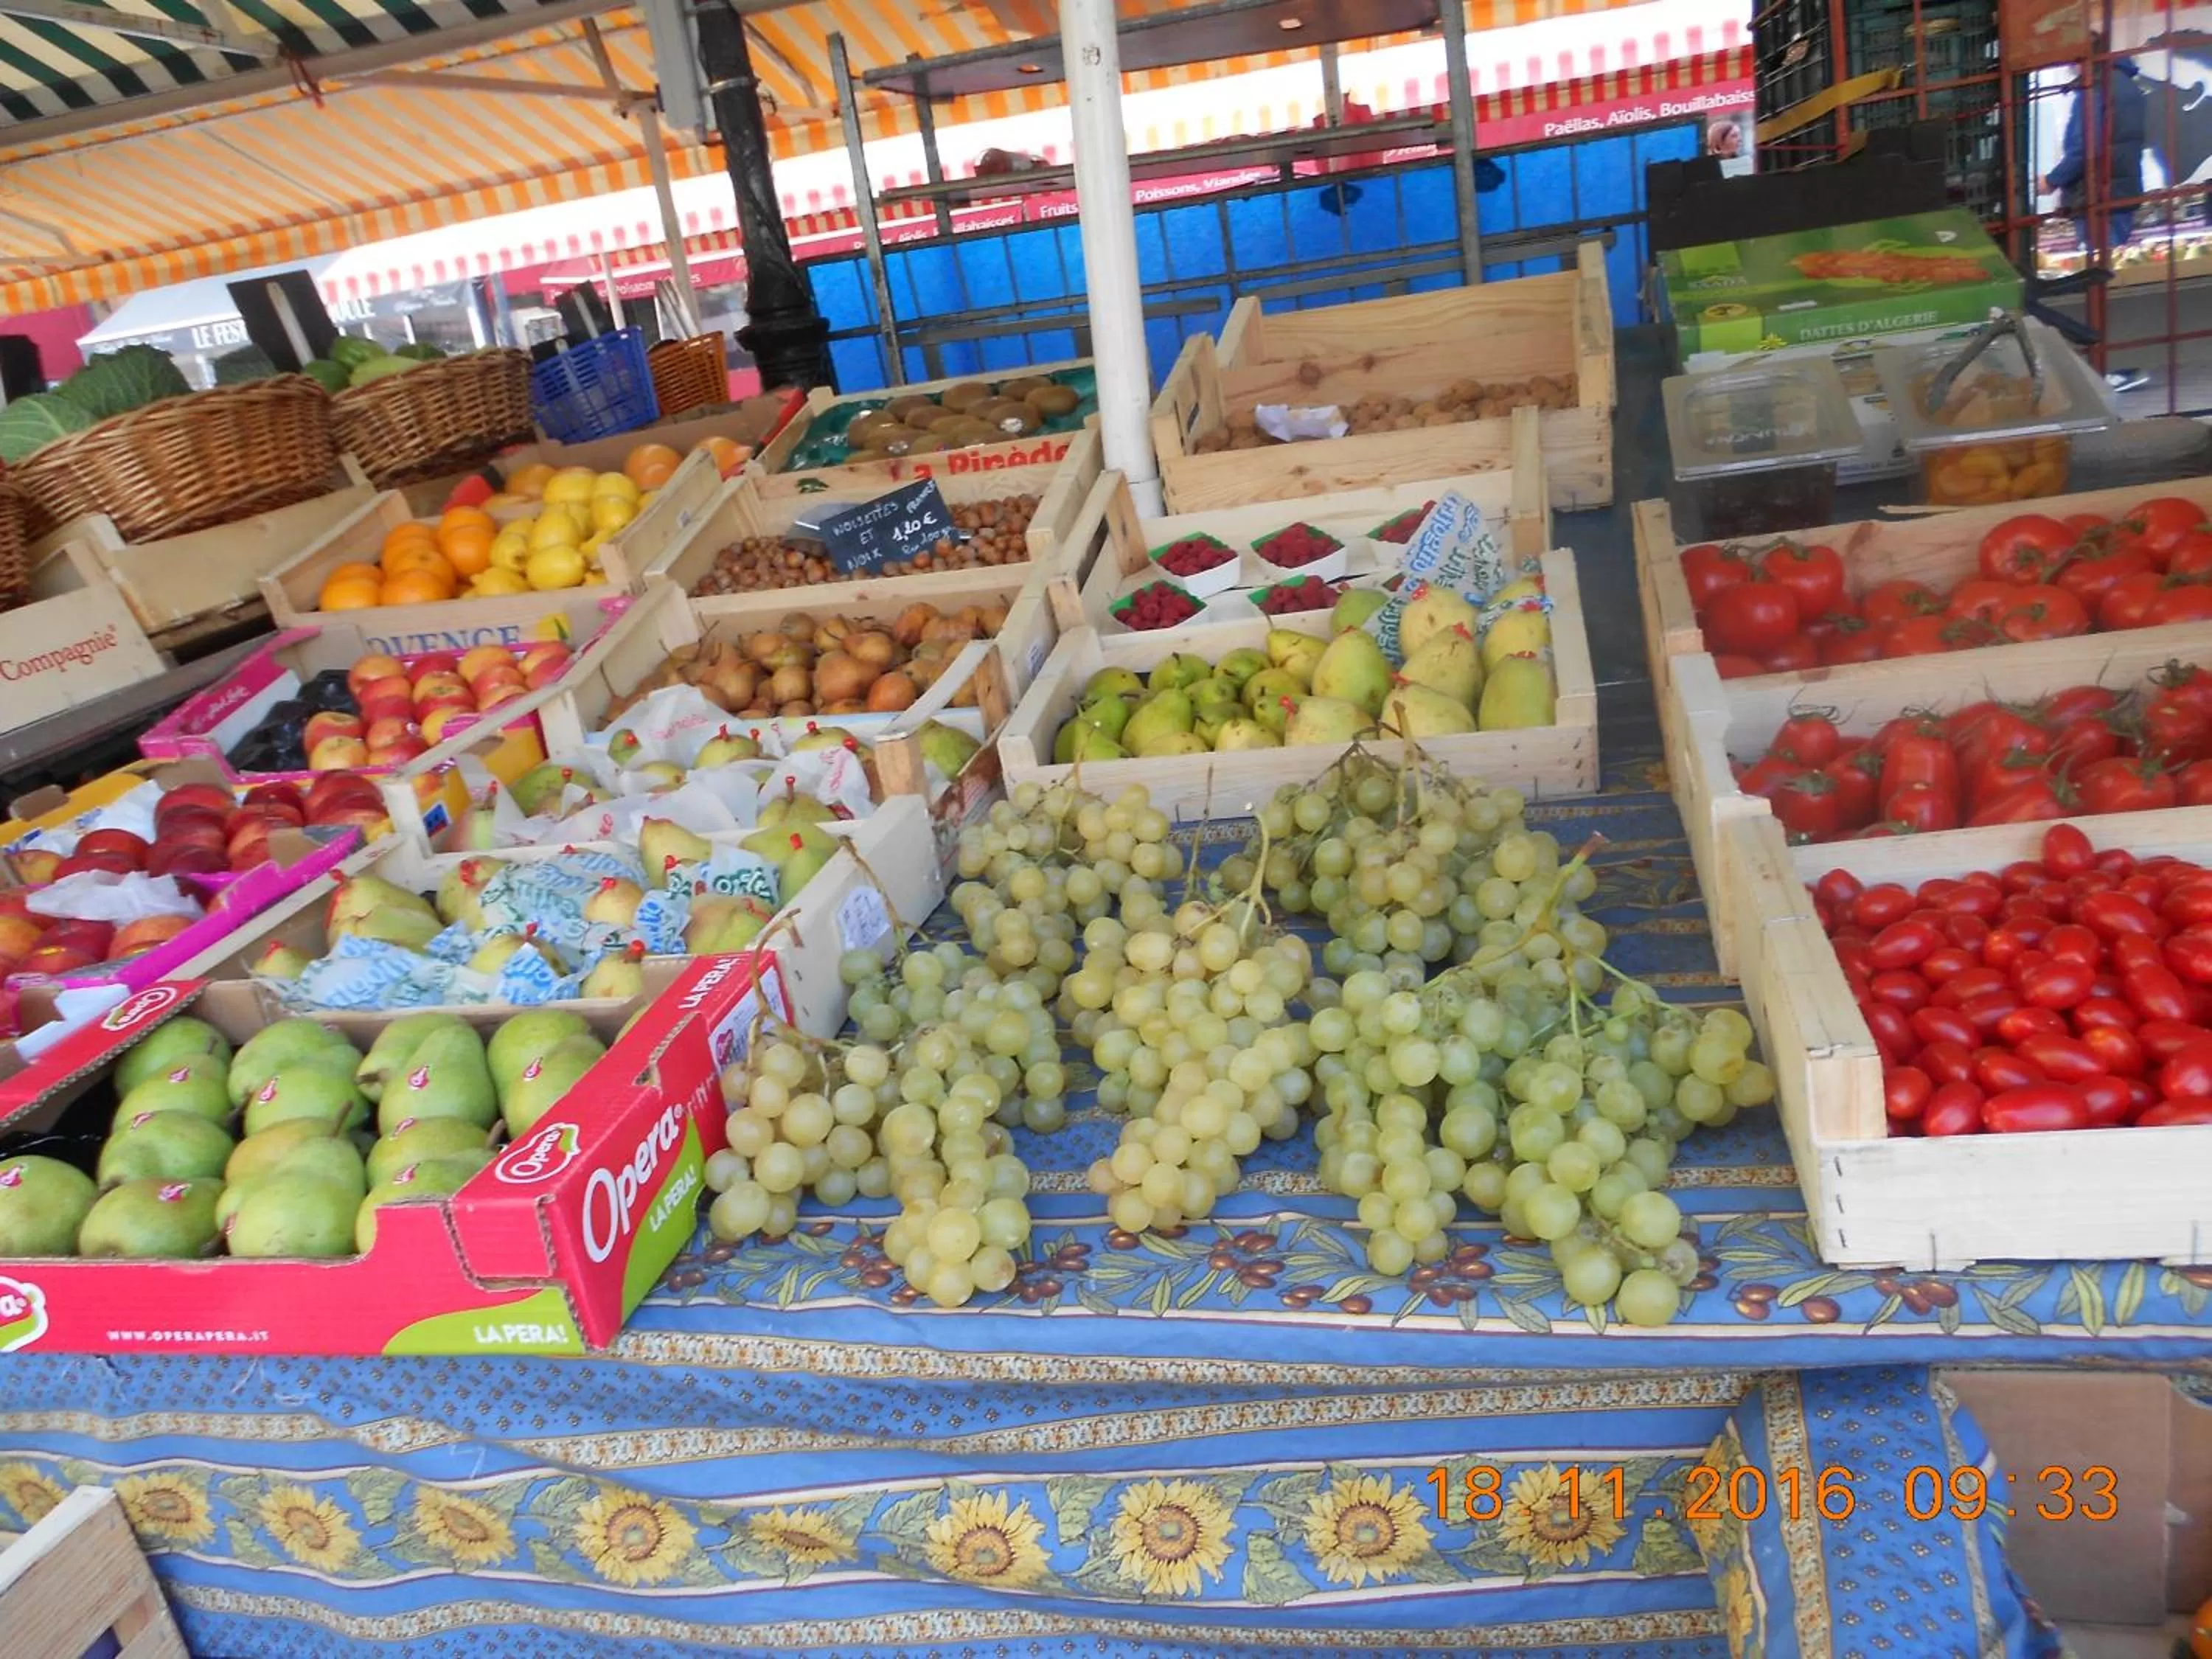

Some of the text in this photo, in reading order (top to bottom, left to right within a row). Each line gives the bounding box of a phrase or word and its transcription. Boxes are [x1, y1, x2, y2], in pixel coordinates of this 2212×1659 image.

[1040, 202, 1079, 219] Fruits
[191, 325, 213, 349] LE
[859, 527, 874, 546] ET
[846, 547, 883, 570] NOIX
[0, 627, 119, 681] Compagnie
[510, 1128, 561, 1177] Opera
[650, 1204, 667, 1233] LA
[473, 1324, 569, 1344] LA PERA!
